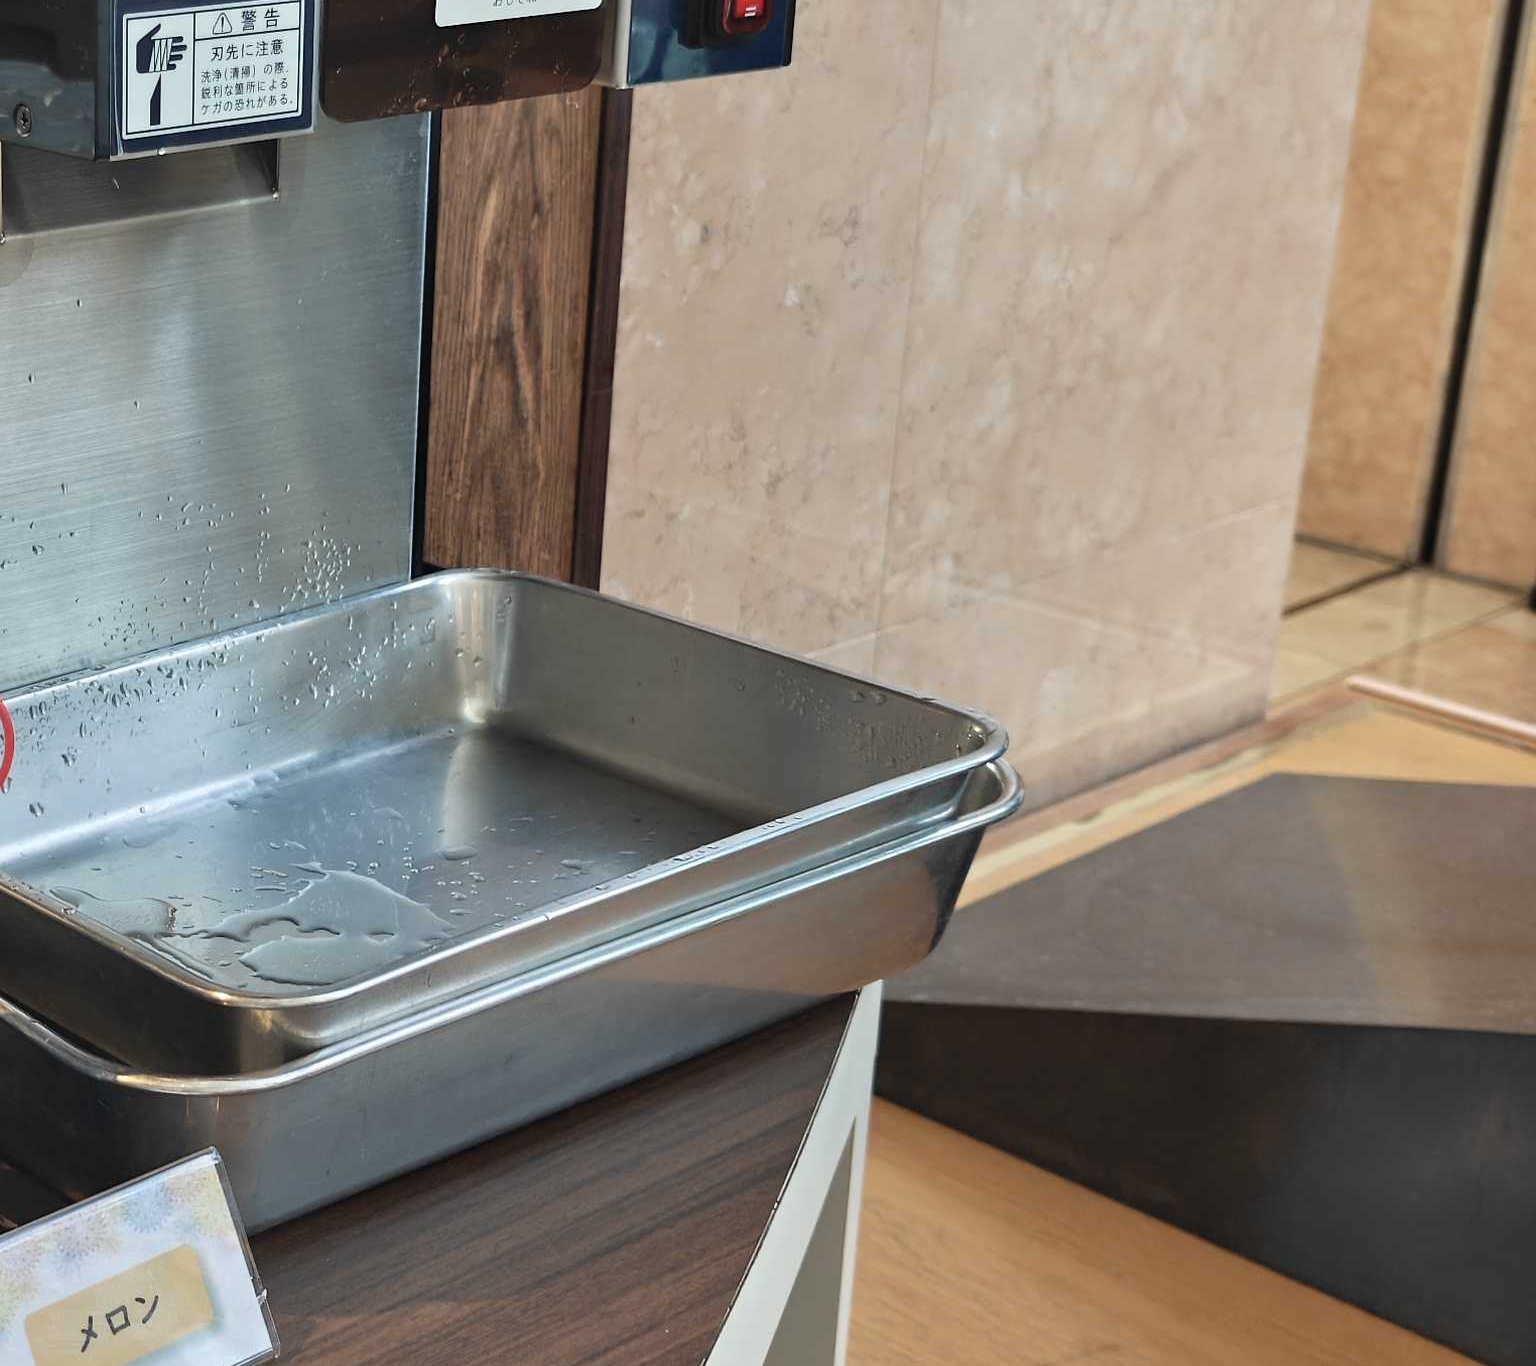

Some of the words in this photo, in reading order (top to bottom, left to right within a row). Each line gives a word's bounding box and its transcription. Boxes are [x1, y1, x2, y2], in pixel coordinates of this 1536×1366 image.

[240, 8, 280, 32] 警告
[210, 39, 284, 63] 刃先に注意
[80, 1294, 159, 1353] メロン
